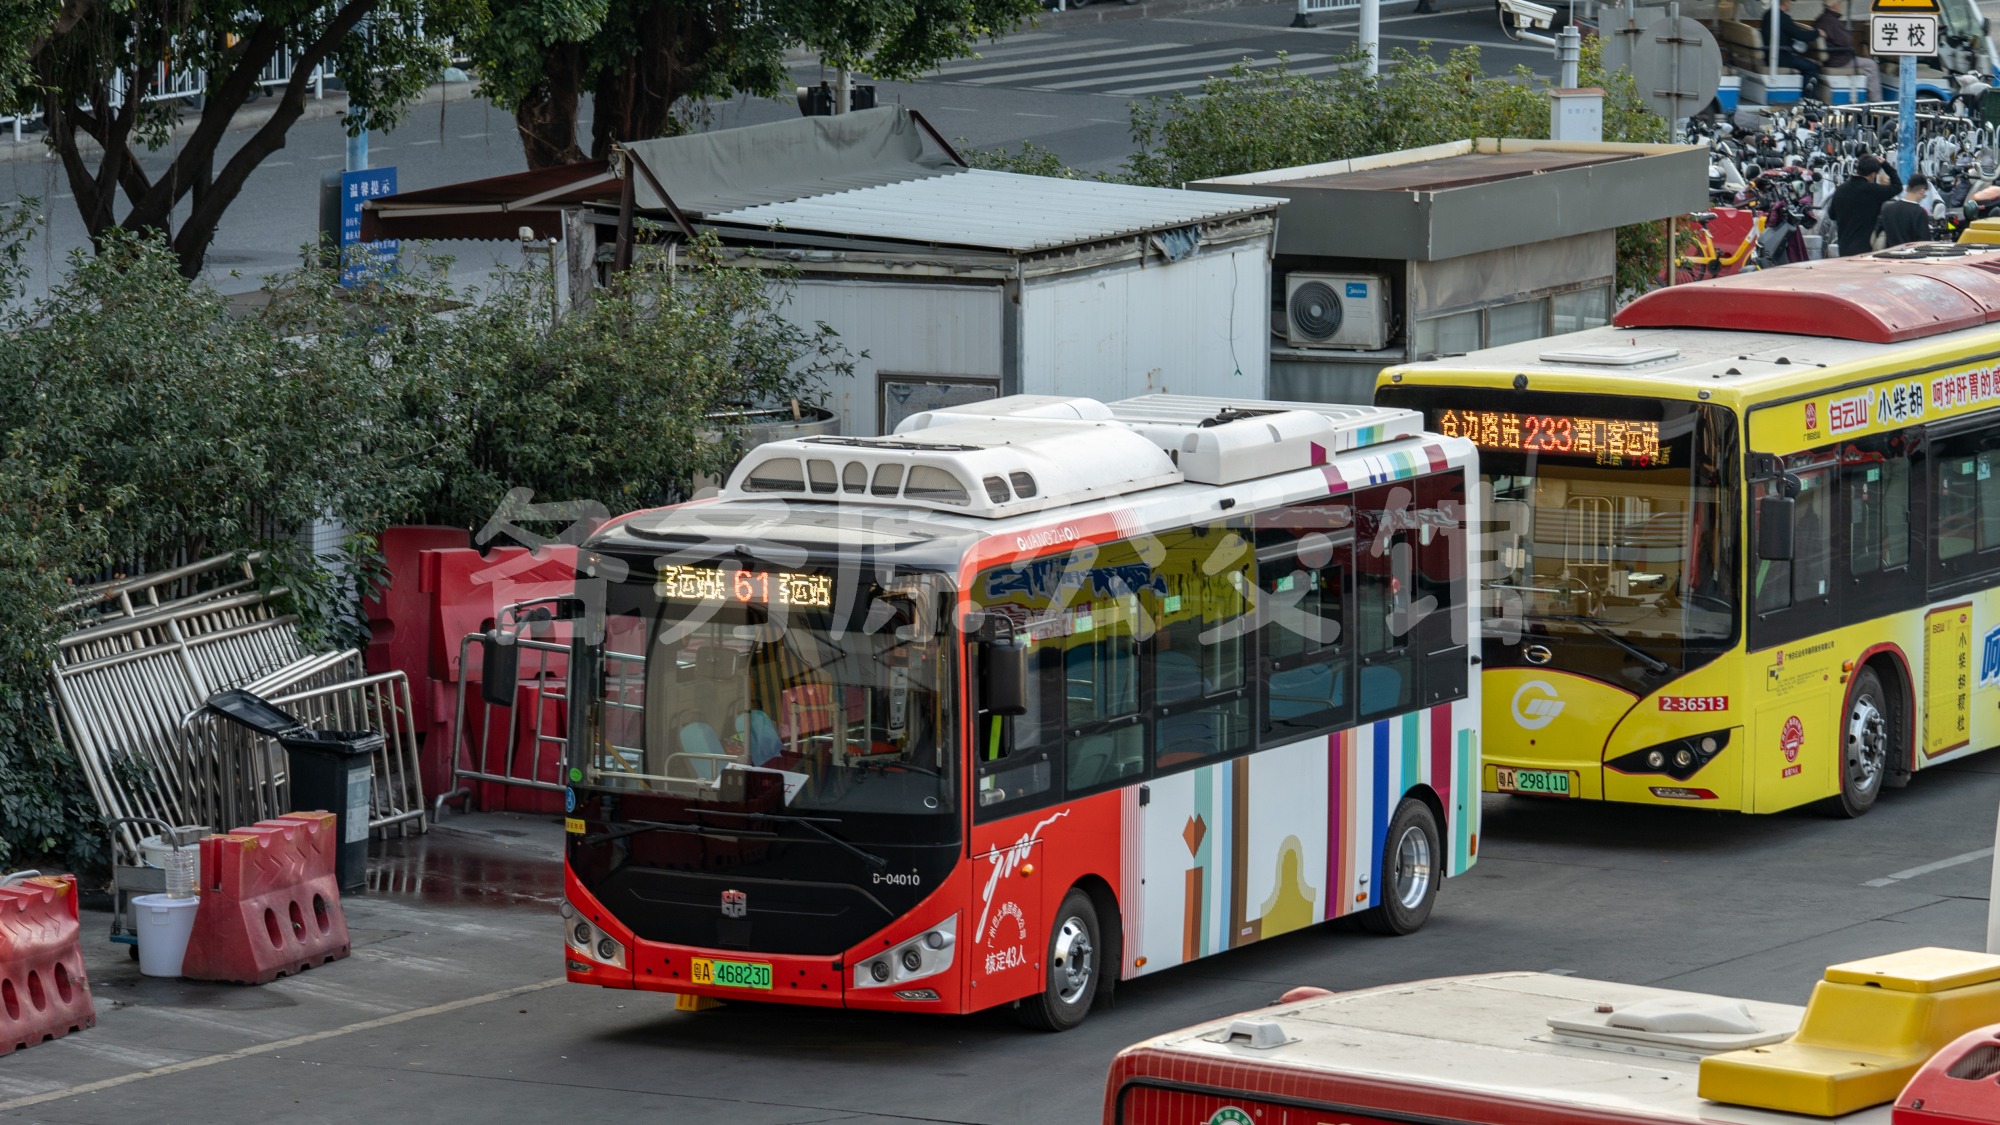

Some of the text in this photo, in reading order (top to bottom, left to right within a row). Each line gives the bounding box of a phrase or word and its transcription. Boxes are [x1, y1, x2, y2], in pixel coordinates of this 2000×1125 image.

[1881, 22, 1926, 47] 学校
[349, 179, 390, 198] 温馨提示
[1829, 398, 1868, 432] 白云山
[1877, 384, 1923, 422] 小柴胡
[1523, 416, 1573, 452] 233
[1016, 525, 1080, 552] GUANGZHOU
[734, 569, 768, 604] 61
[1662, 697, 1725, 711] 2-36513
[872, 872, 921, 886] D-04010
[986, 901, 1027, 949] 广州巴士集团有限公司
[984, 944, 1027, 975] 核定43人
